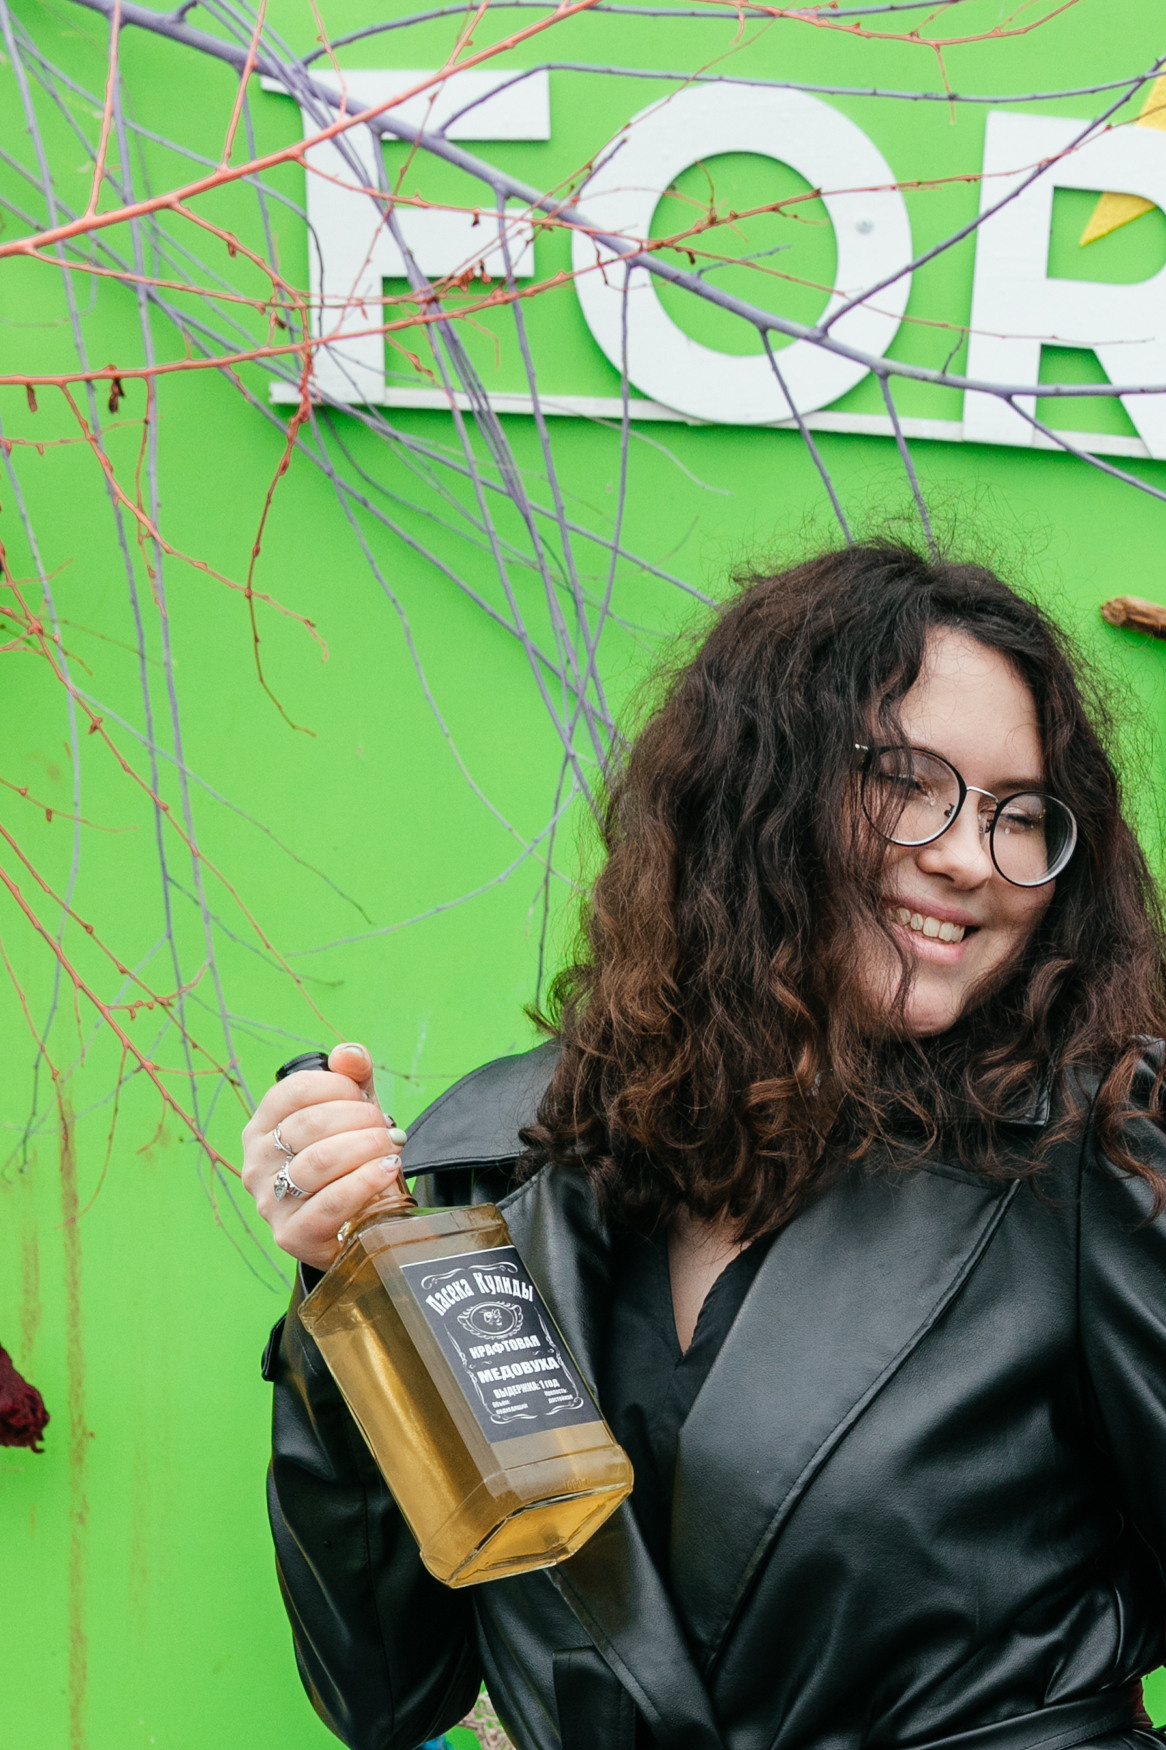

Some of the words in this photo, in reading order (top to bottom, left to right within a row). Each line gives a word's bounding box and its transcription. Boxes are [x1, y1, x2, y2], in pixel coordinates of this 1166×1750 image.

[425, 1278, 474, 1316] Пасека
[473, 1272, 534, 1302] Кулиды
[469, 1335, 541, 1359] КРАФТОВАЯ
[477, 1356, 560, 1384] МЕДОВУХА
